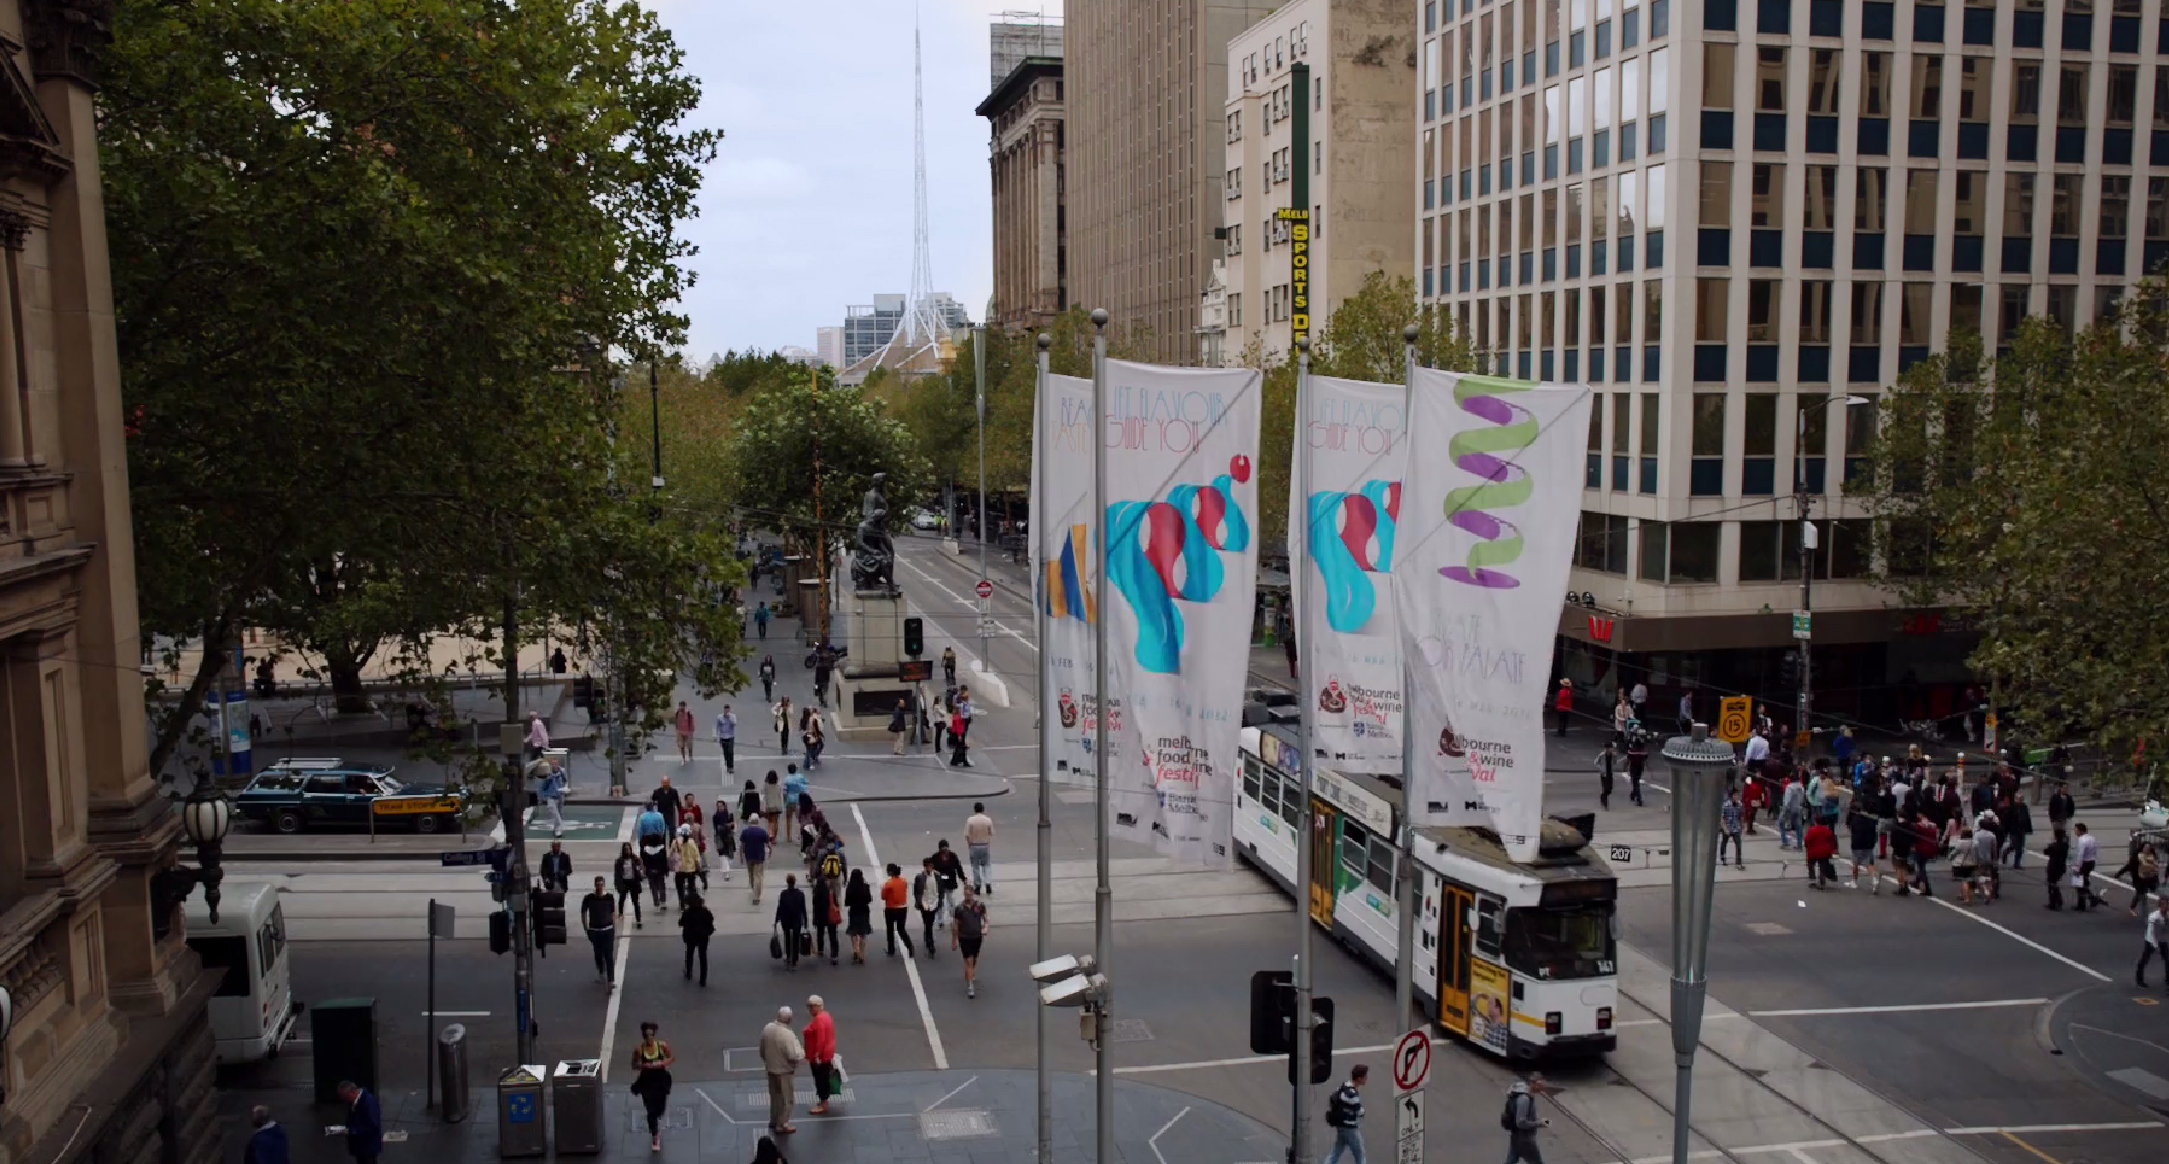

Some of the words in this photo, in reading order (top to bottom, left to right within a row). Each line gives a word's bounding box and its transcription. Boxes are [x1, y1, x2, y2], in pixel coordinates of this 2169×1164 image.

[1293, 225, 1308, 308] SPORTS
[1728, 719, 1741, 732] 15
[1481, 753, 1514, 768] wine
[1611, 847, 1630, 860] 207
